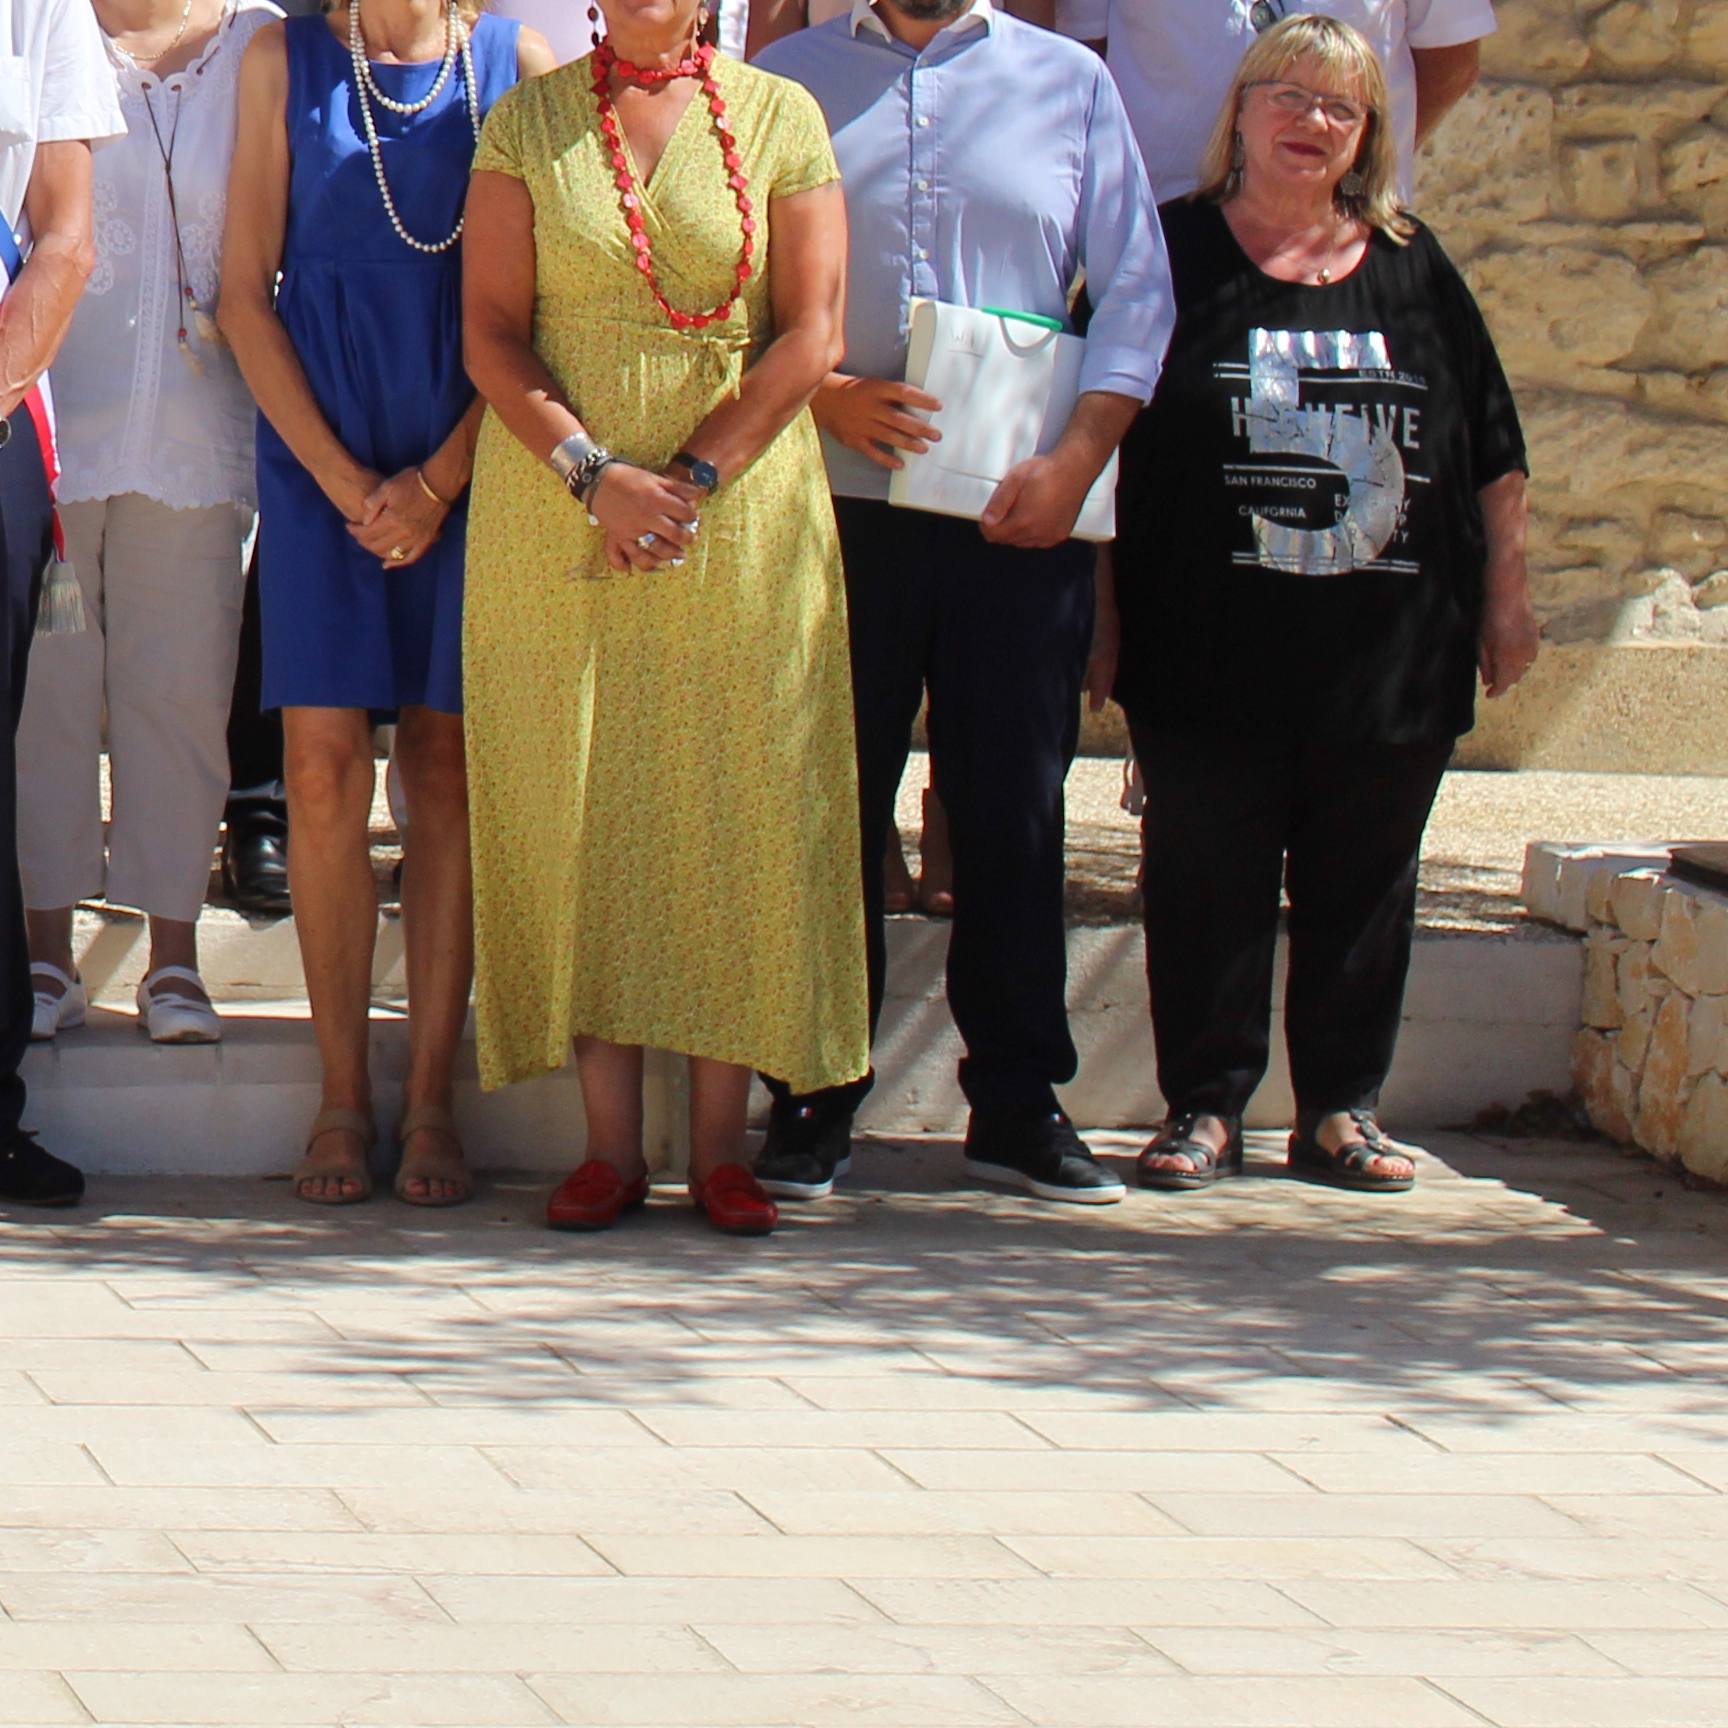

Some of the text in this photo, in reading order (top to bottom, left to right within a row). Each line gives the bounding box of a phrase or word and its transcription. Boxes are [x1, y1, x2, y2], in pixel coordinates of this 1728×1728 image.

[1224, 474, 1317, 489] SAN FRANCISCO
[1238, 504, 1306, 518] CALIFORNIA
